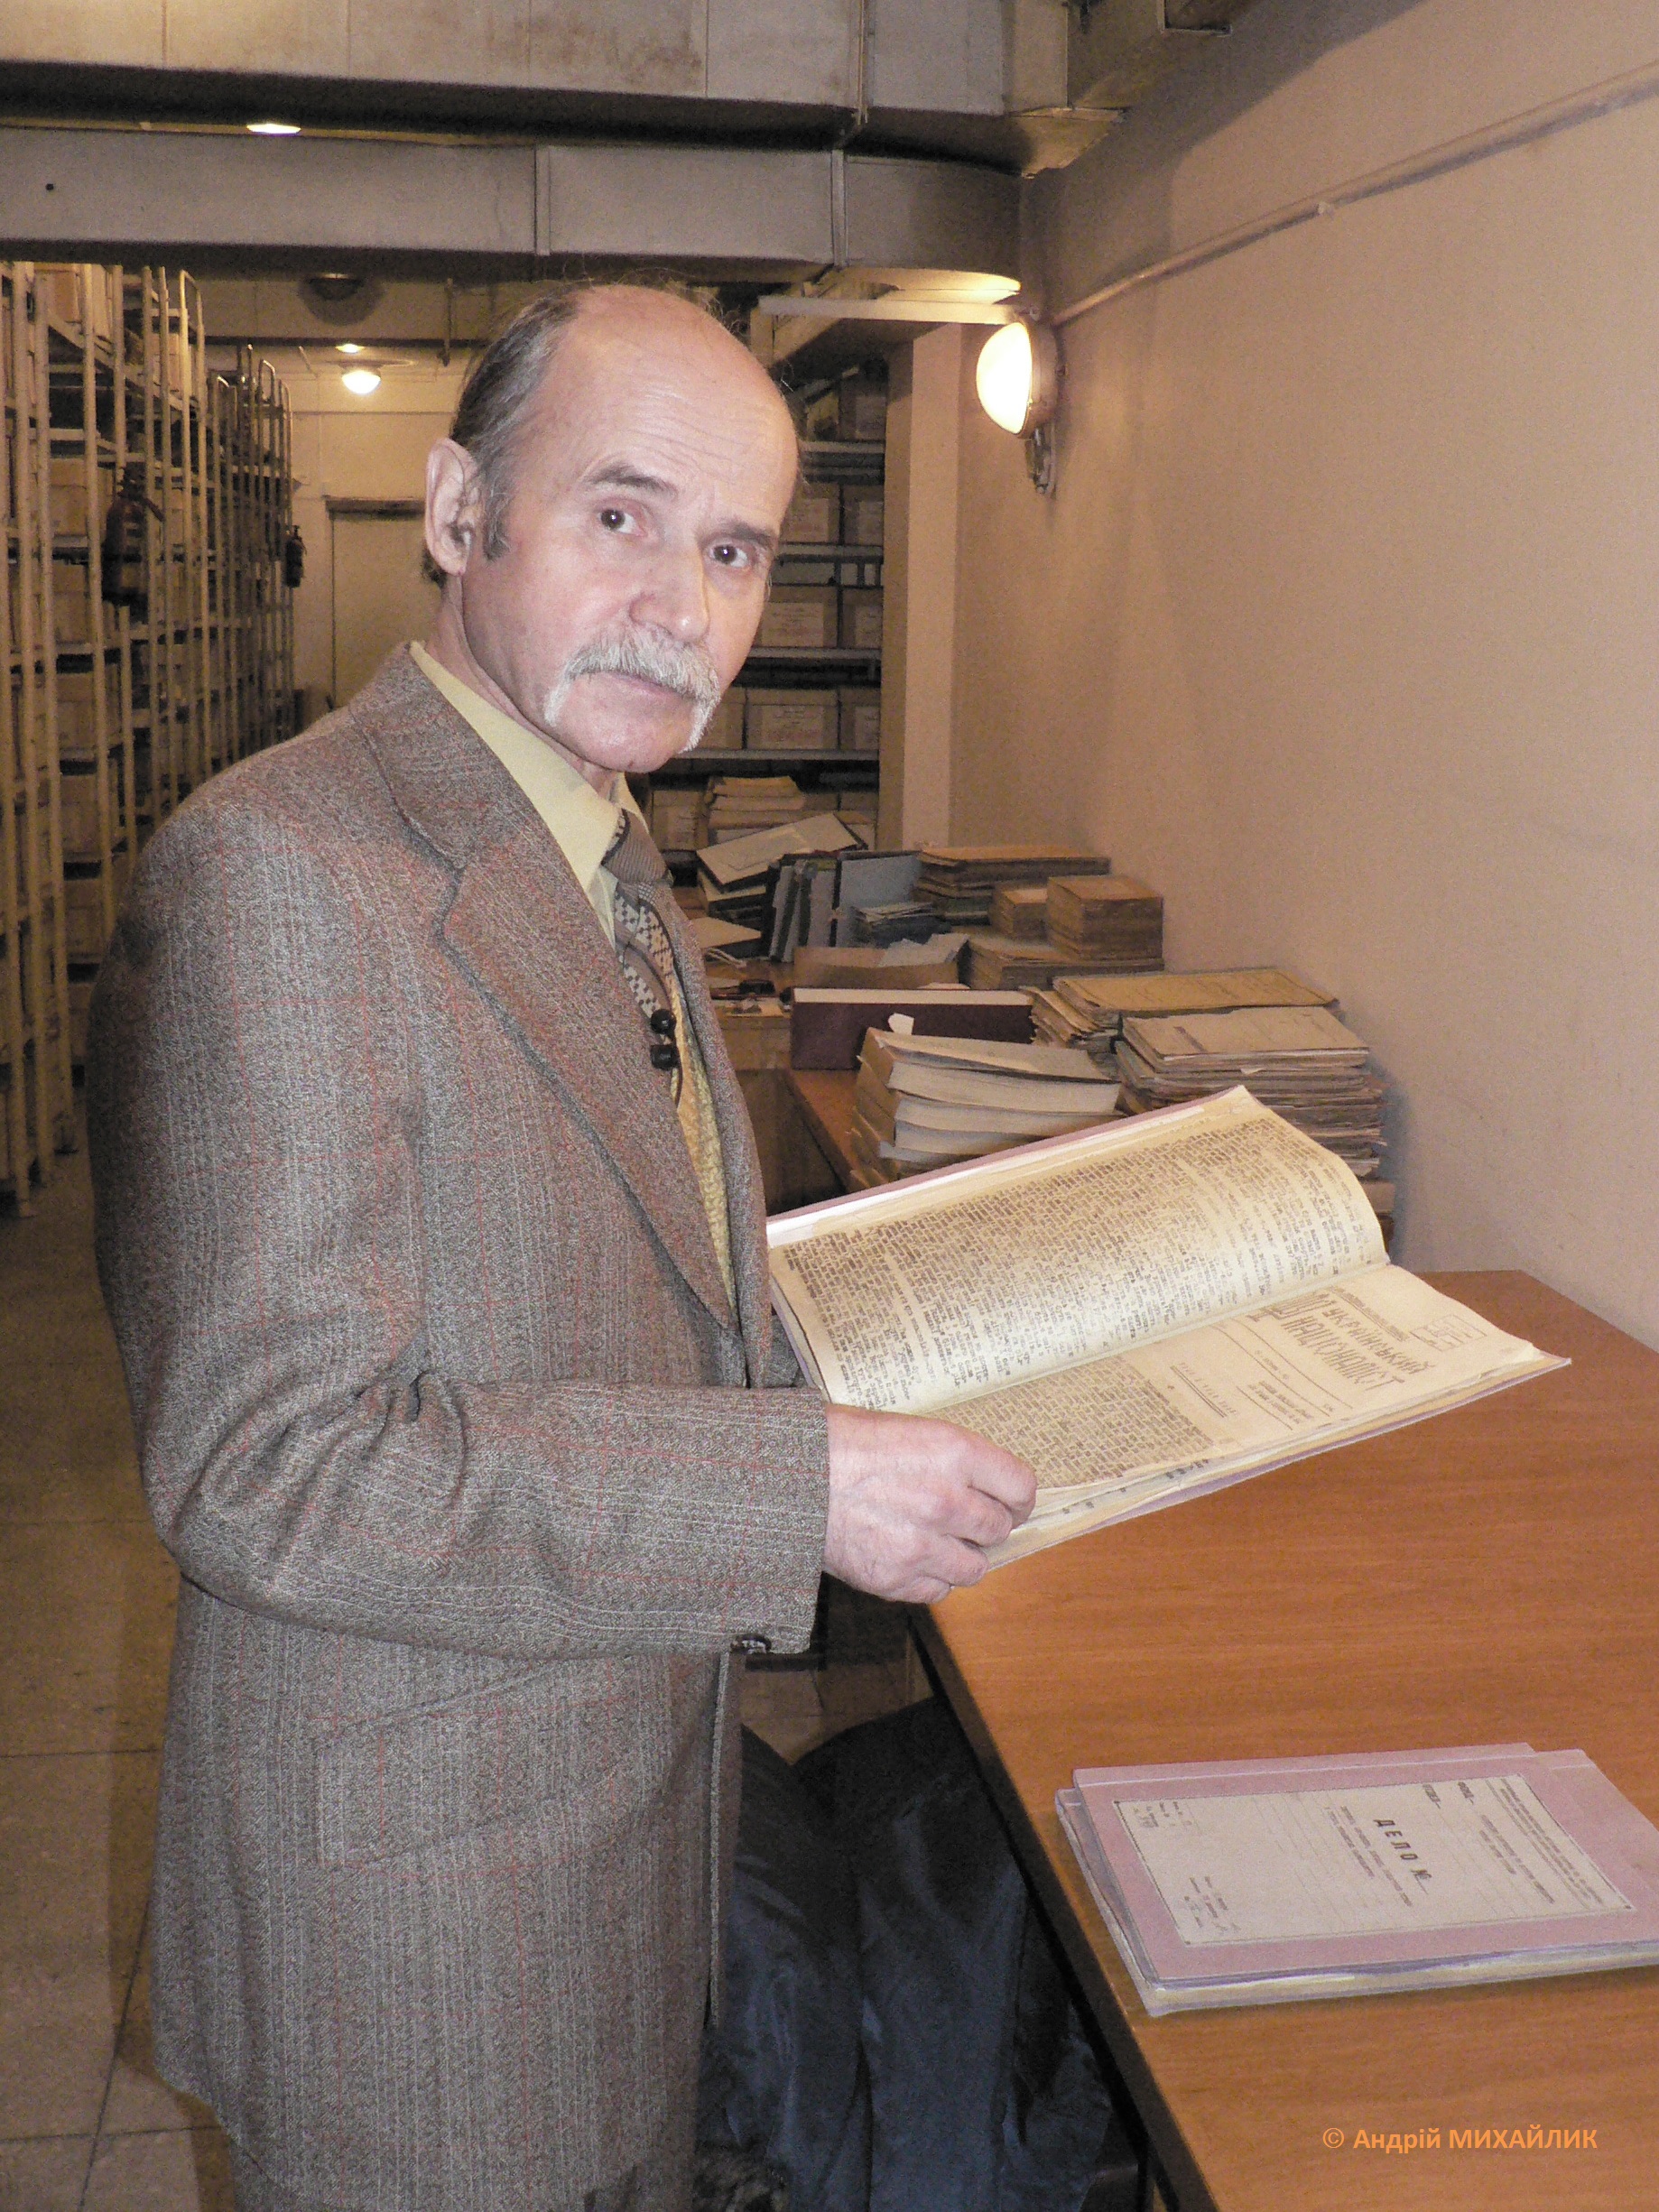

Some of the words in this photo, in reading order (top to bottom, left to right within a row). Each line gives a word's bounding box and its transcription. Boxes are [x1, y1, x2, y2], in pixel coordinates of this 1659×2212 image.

[1281, 1316, 1404, 1391] НАЦІОНАЛІСТ
[1322, 1308, 1435, 1374] УКРАЇНСЬКИЙ
[1373, 1819, 1418, 1860] ДЕЛО
